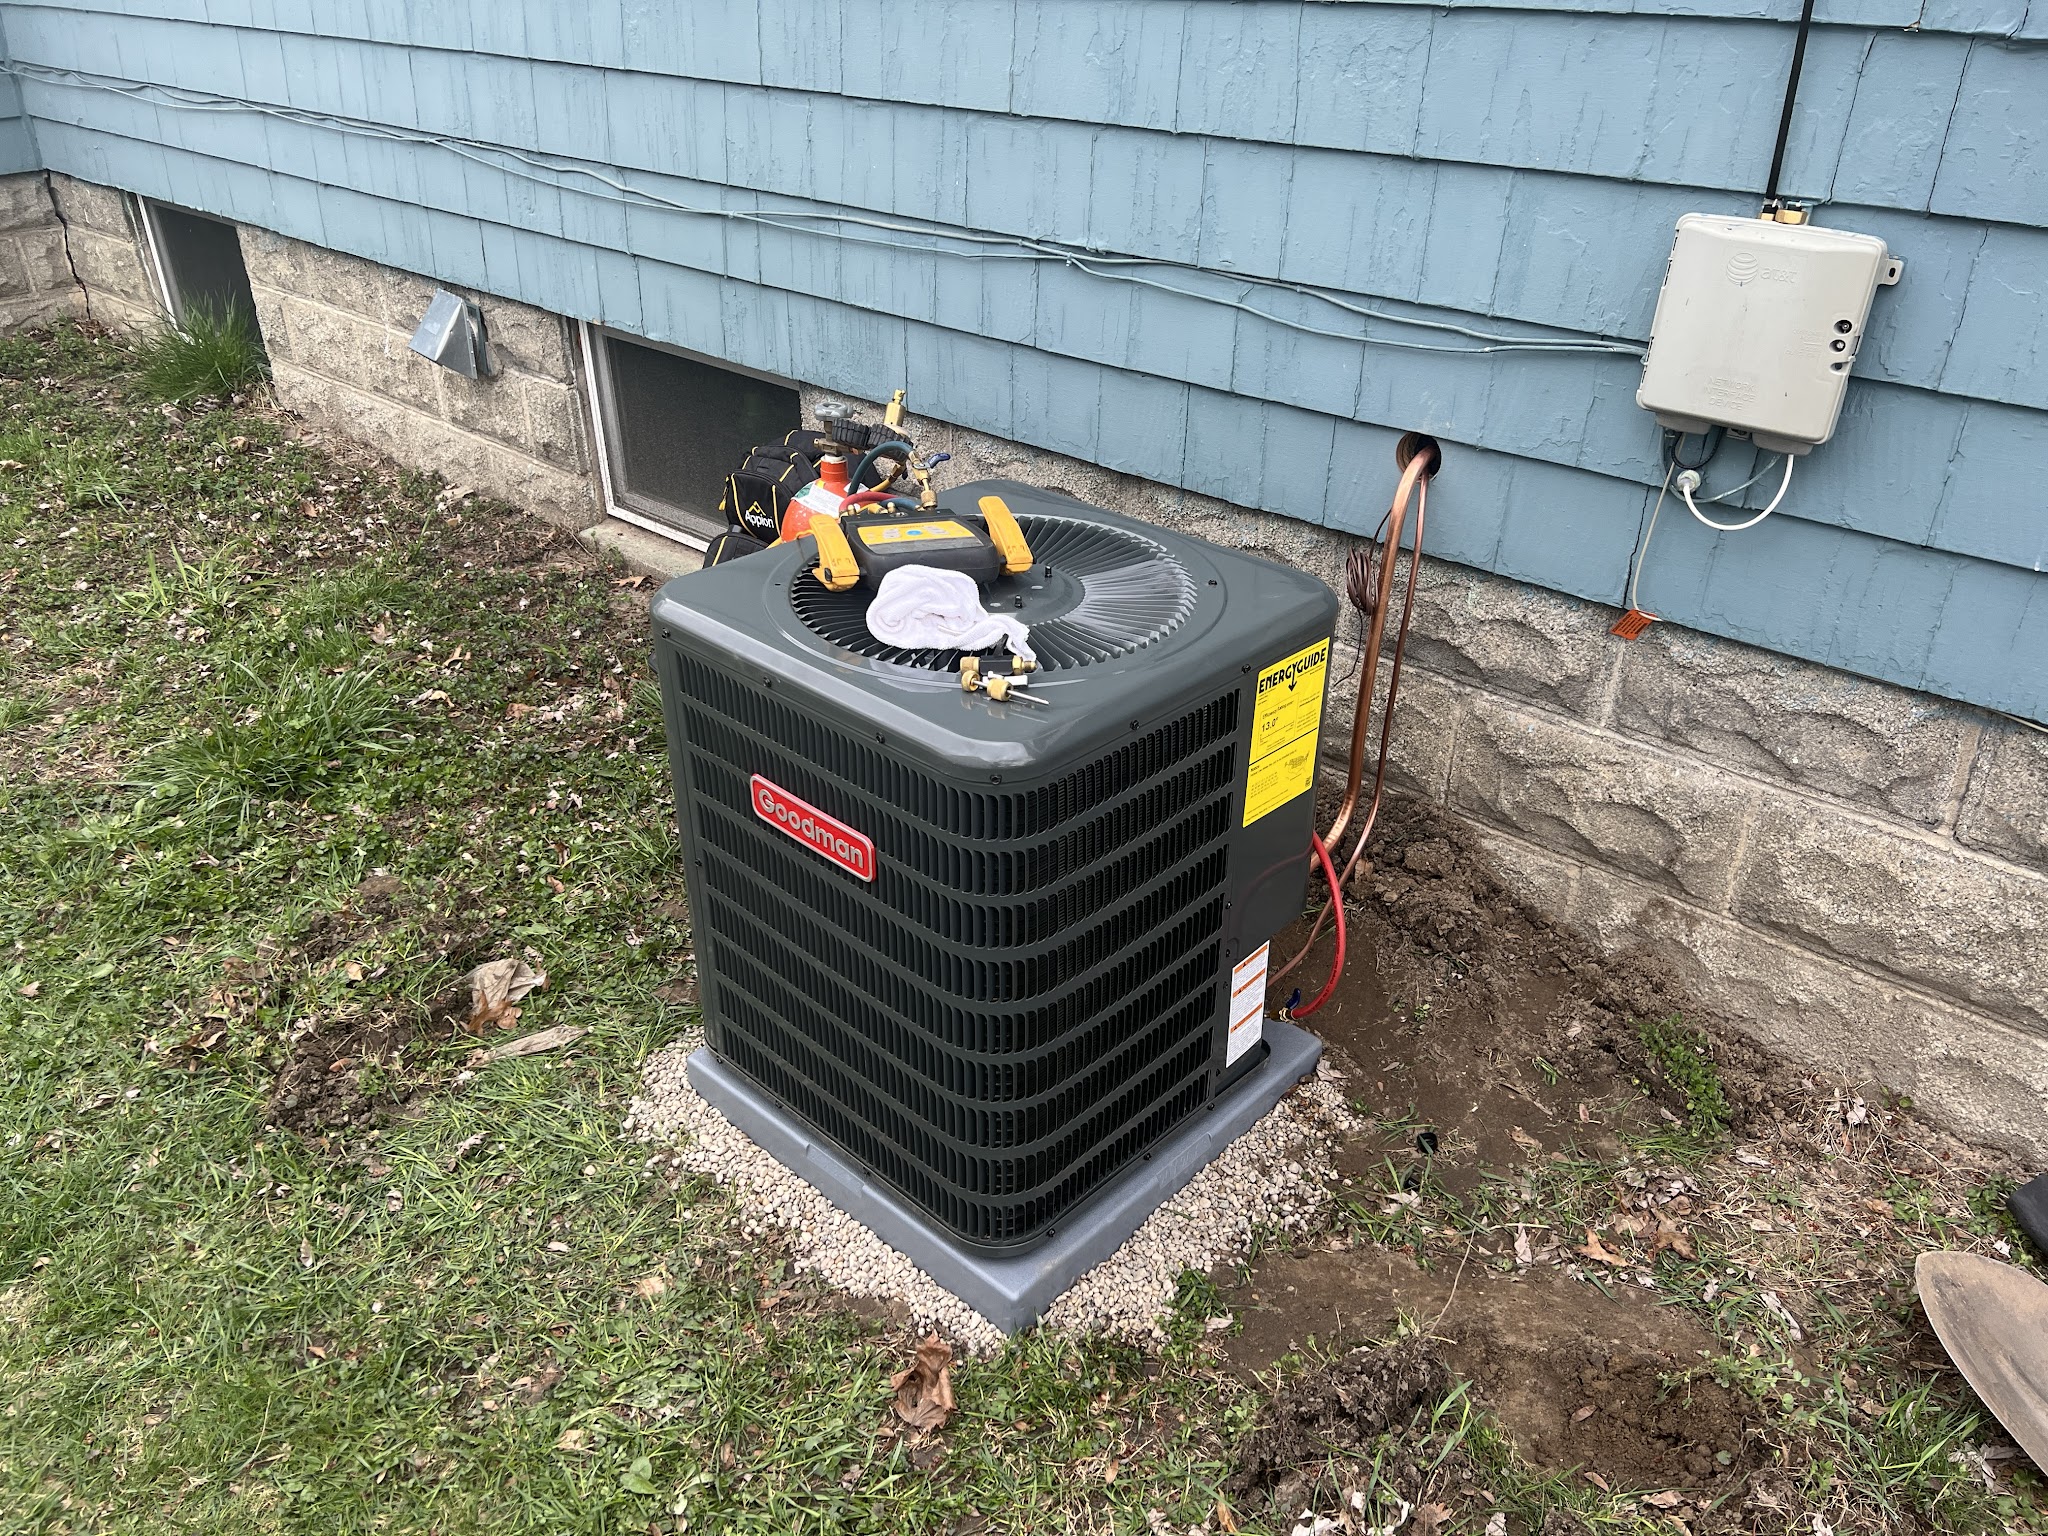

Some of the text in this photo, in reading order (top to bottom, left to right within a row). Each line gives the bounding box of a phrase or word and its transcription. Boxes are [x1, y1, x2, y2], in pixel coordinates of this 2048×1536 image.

[1761, 266, 1798, 284] at&t
[1709, 376, 1755, 392] NETWORK
[1704, 385, 1757, 403] INTERFACE
[1708, 396, 1744, 411] DEVICE
[745, 509, 775, 529] Appion
[1258, 647, 1327, 695] ENERGYGUIDE
[758, 788, 864, 869] Goodman
